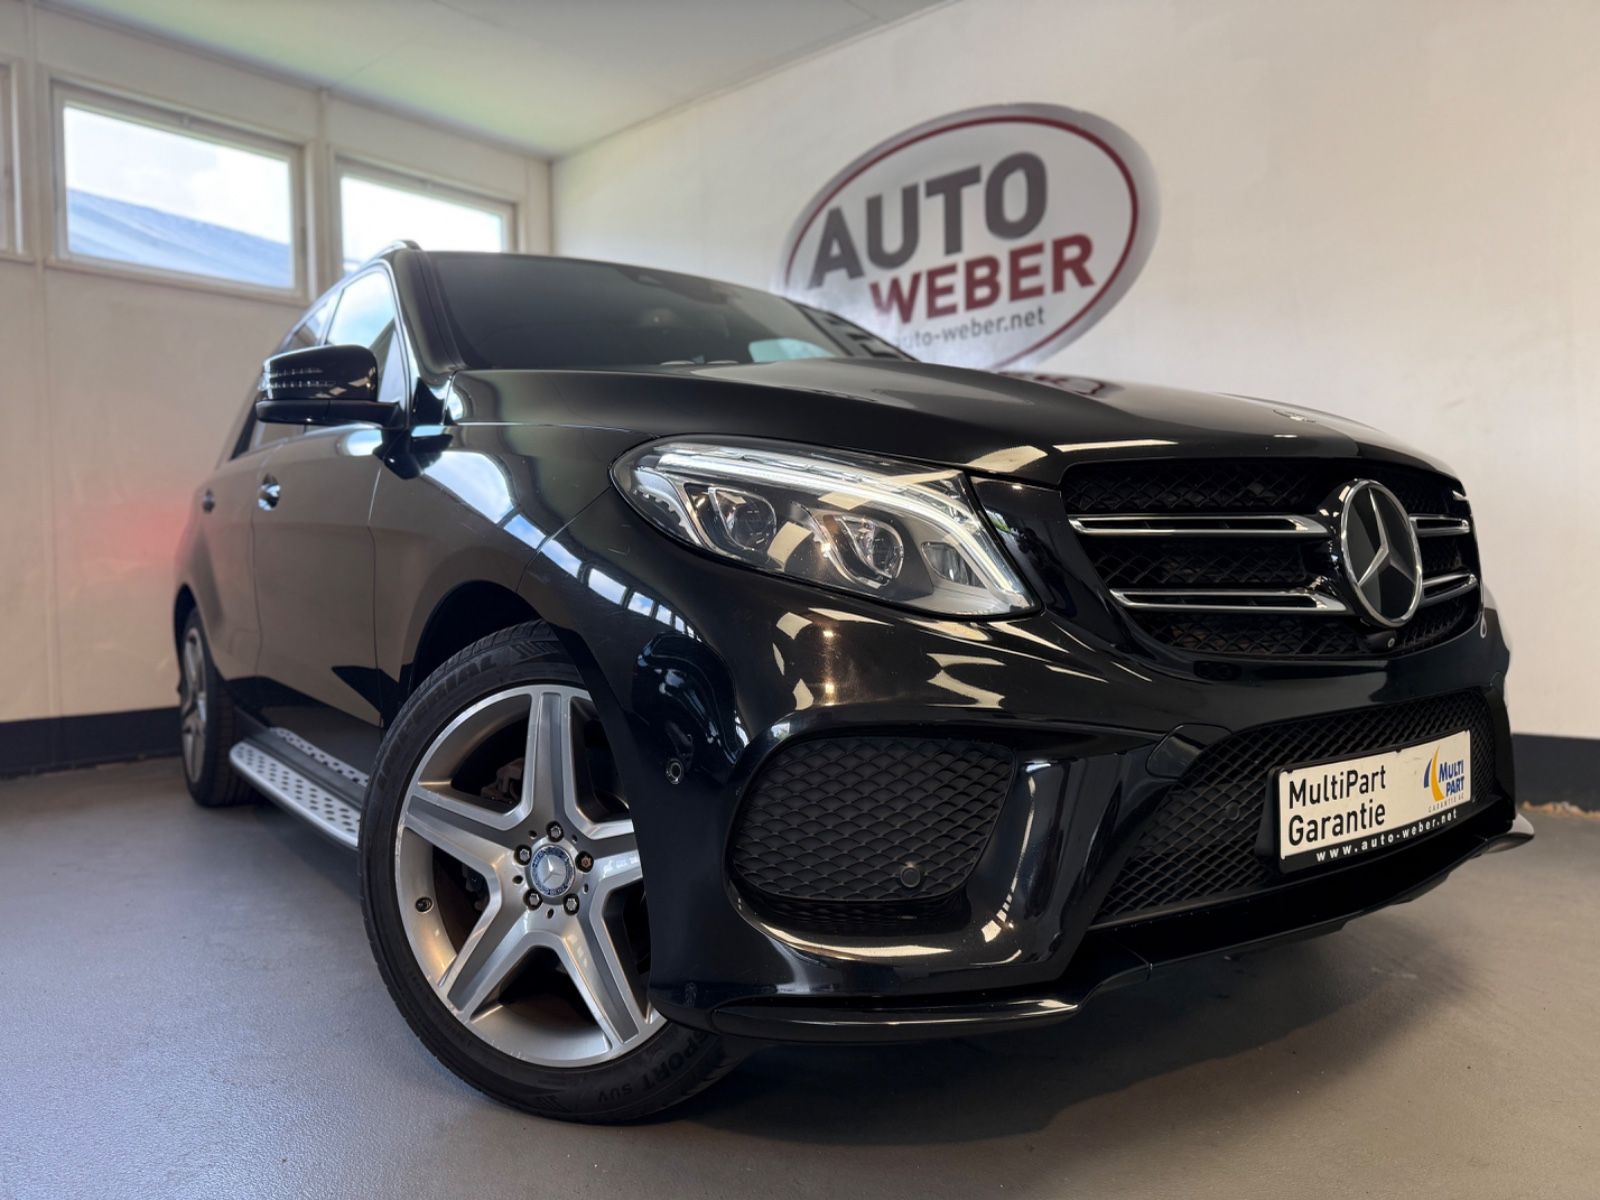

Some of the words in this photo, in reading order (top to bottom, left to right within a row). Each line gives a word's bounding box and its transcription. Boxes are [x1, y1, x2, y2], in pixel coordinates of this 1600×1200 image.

[808, 152, 1047, 289] AUTO
[869, 233, 1096, 324] WEBER
[897, 306, 1045, 347] uto-weber.net
[1289, 765, 1386, 809] MultiPart
[1439, 760, 1464, 783] MULTI
[1446, 777, 1465, 797] PART
[1289, 800, 1386, 846] Garantie
[1316, 809, 1457, 861] www.auto-weber.net
